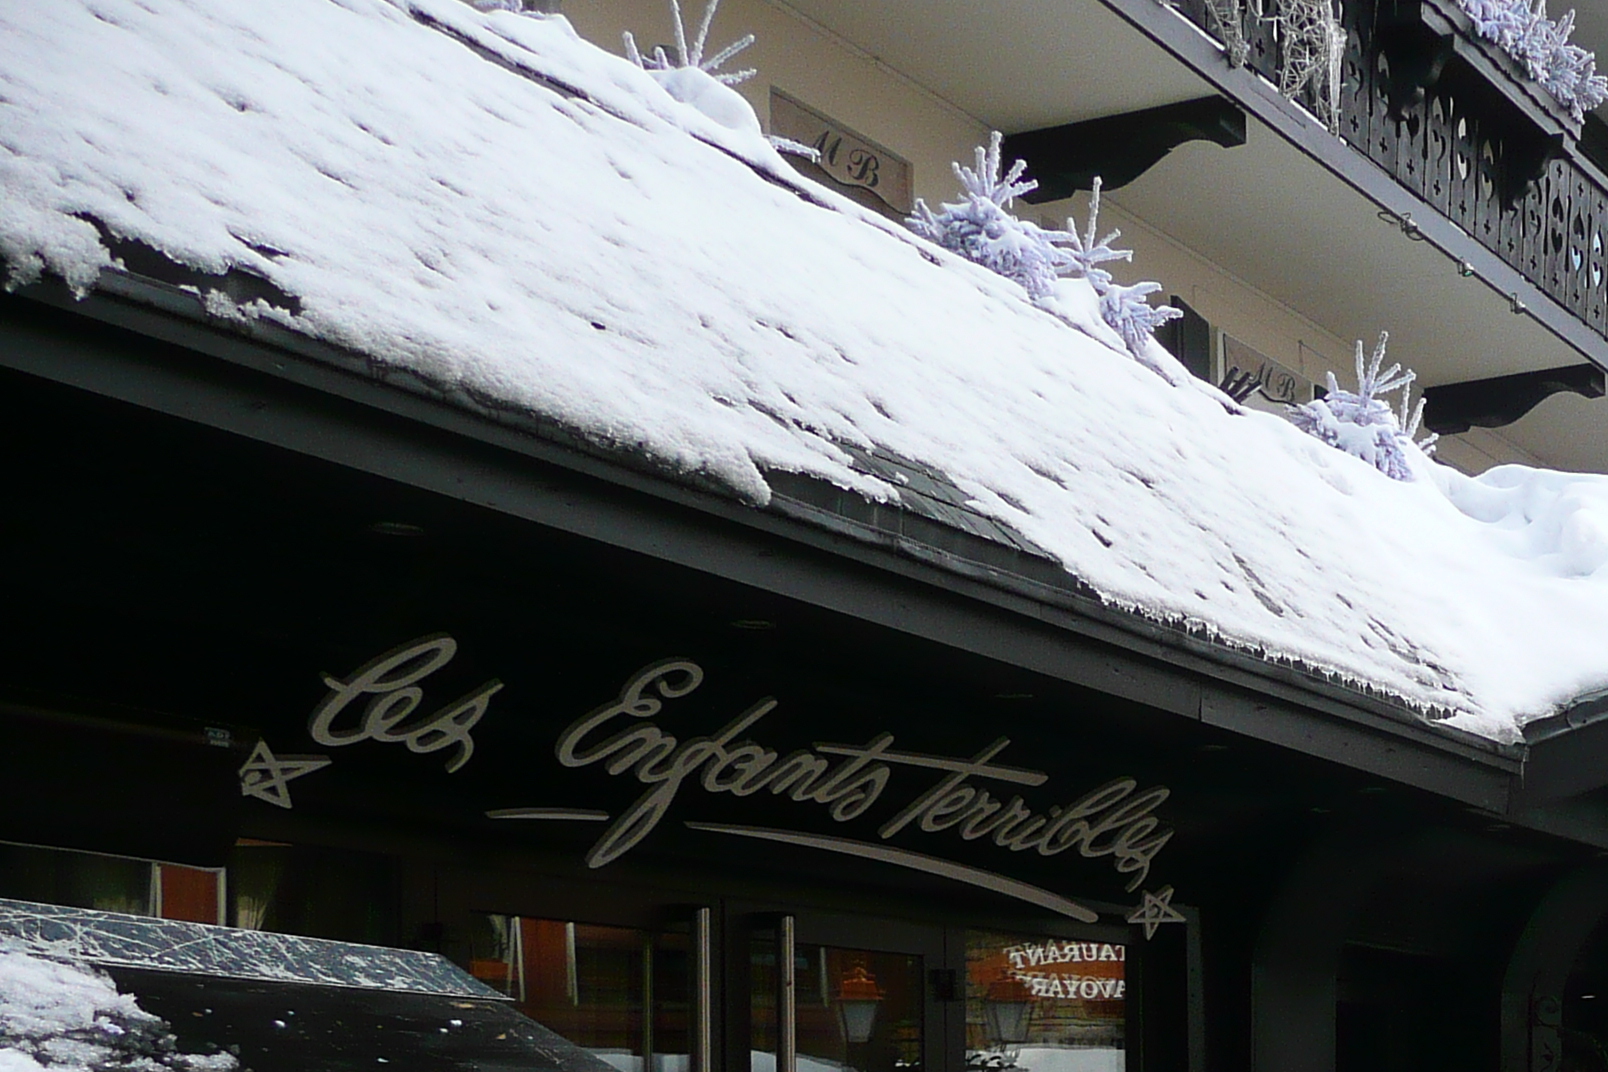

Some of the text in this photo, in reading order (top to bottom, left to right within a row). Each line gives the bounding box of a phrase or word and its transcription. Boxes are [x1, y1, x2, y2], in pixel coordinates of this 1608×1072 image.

[847, 149, 880, 187] B
[554, 655, 892, 869] Enfants
[868, 736, 1174, 893] Terribles
